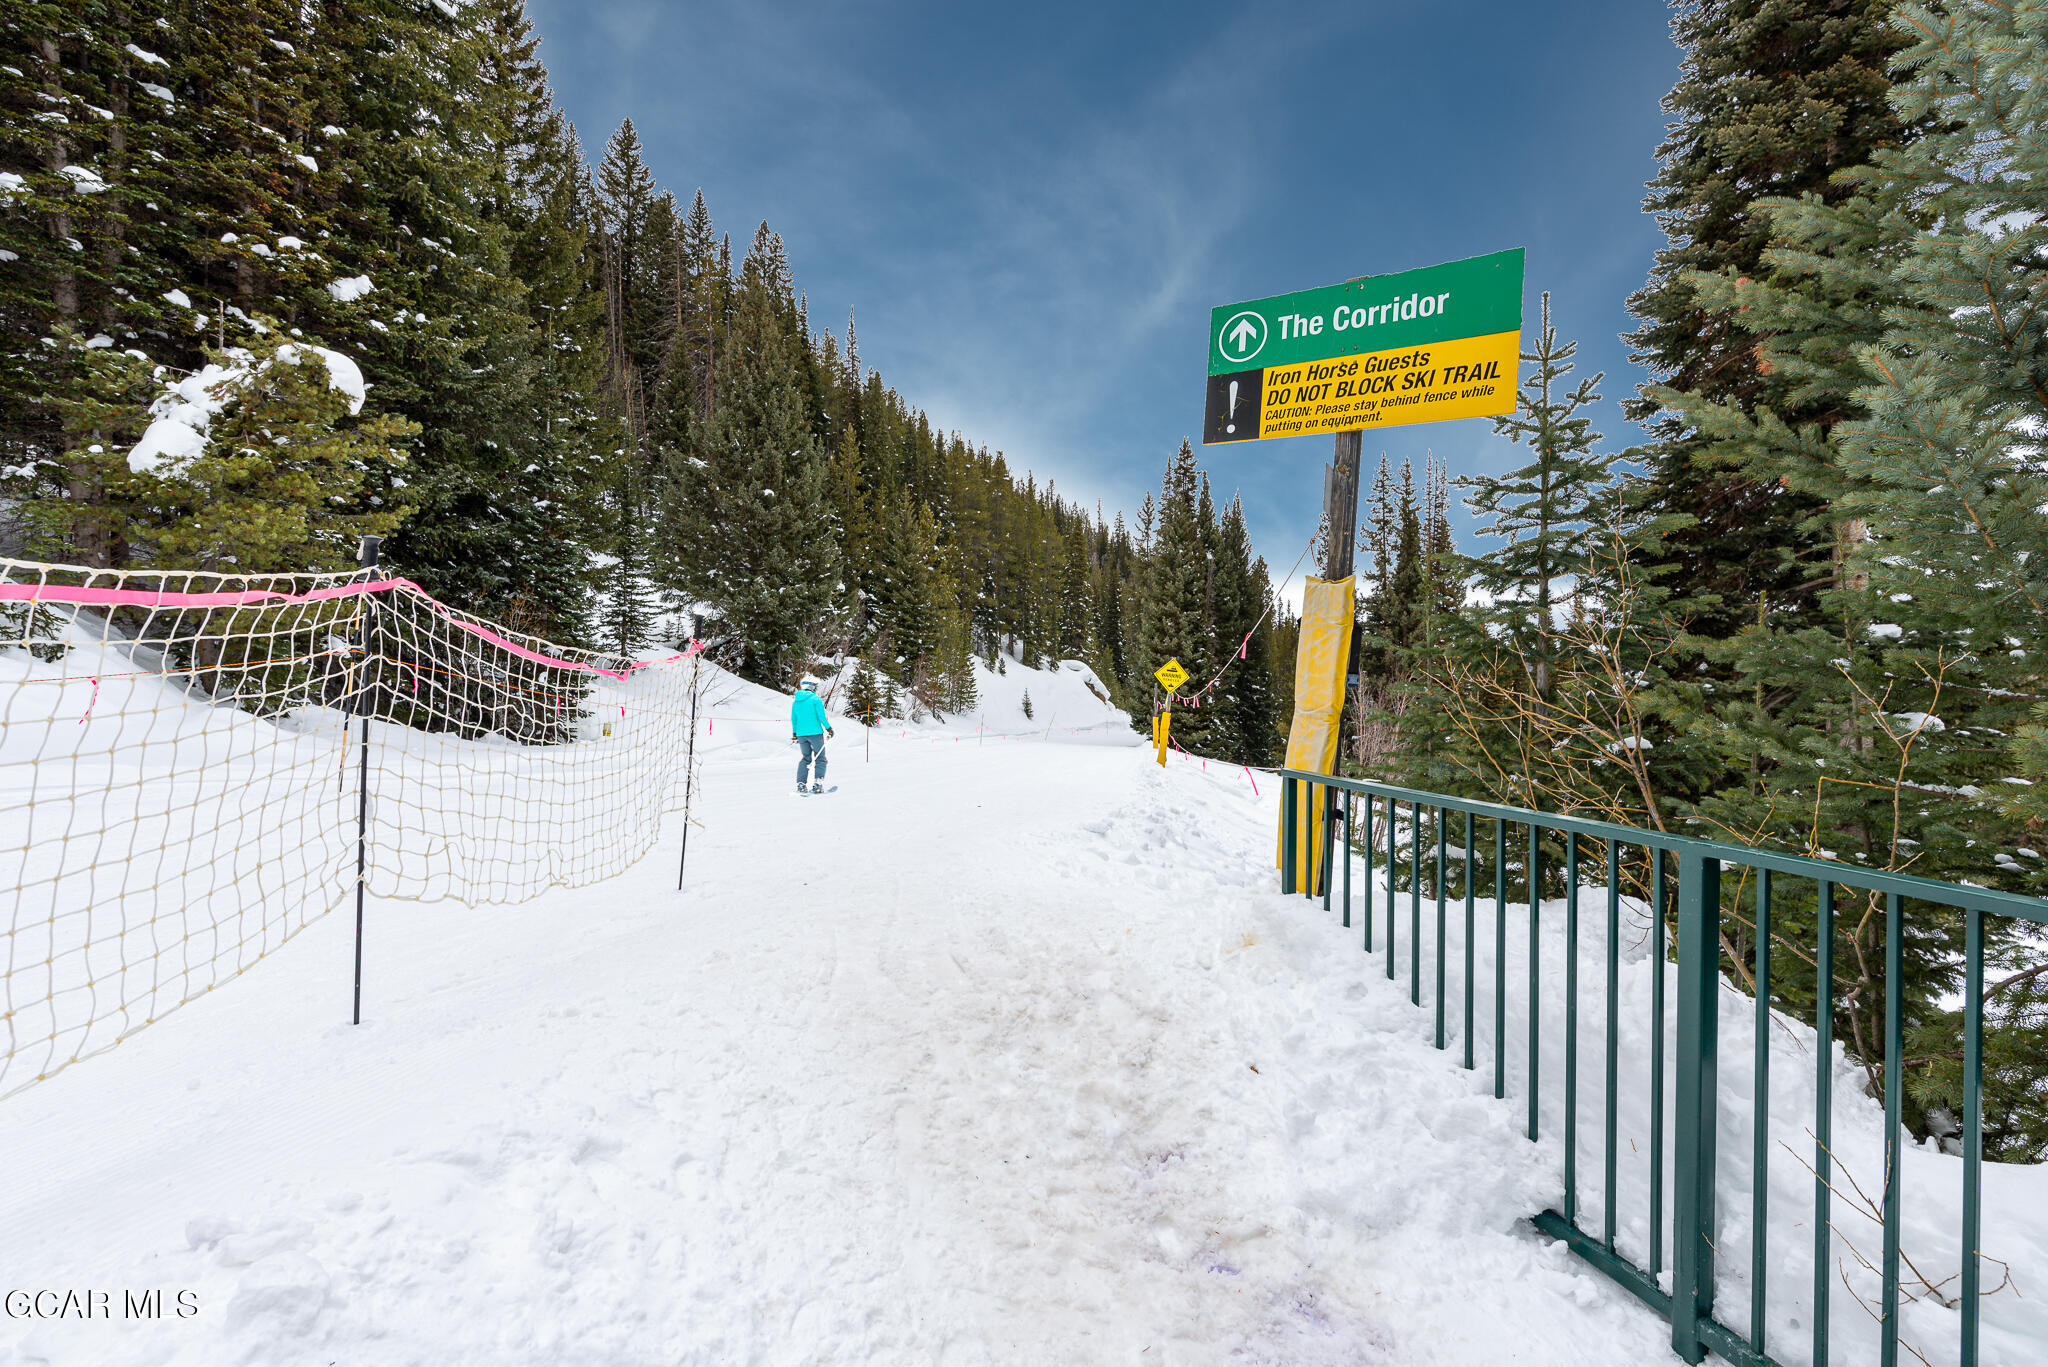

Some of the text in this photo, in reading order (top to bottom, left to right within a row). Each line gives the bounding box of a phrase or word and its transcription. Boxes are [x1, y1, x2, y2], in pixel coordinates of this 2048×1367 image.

[1278, 292, 1450, 340] The Corridor
[1266, 361, 1501, 406] DO NOT BLOCK SKI TRAIL
[1268, 351, 1431, 386] Iron Horse Guests
[1265, 385, 1495, 420] CAUTION: Please stay behind fence while
[1264, 411, 1383, 434] putting on equipment.
